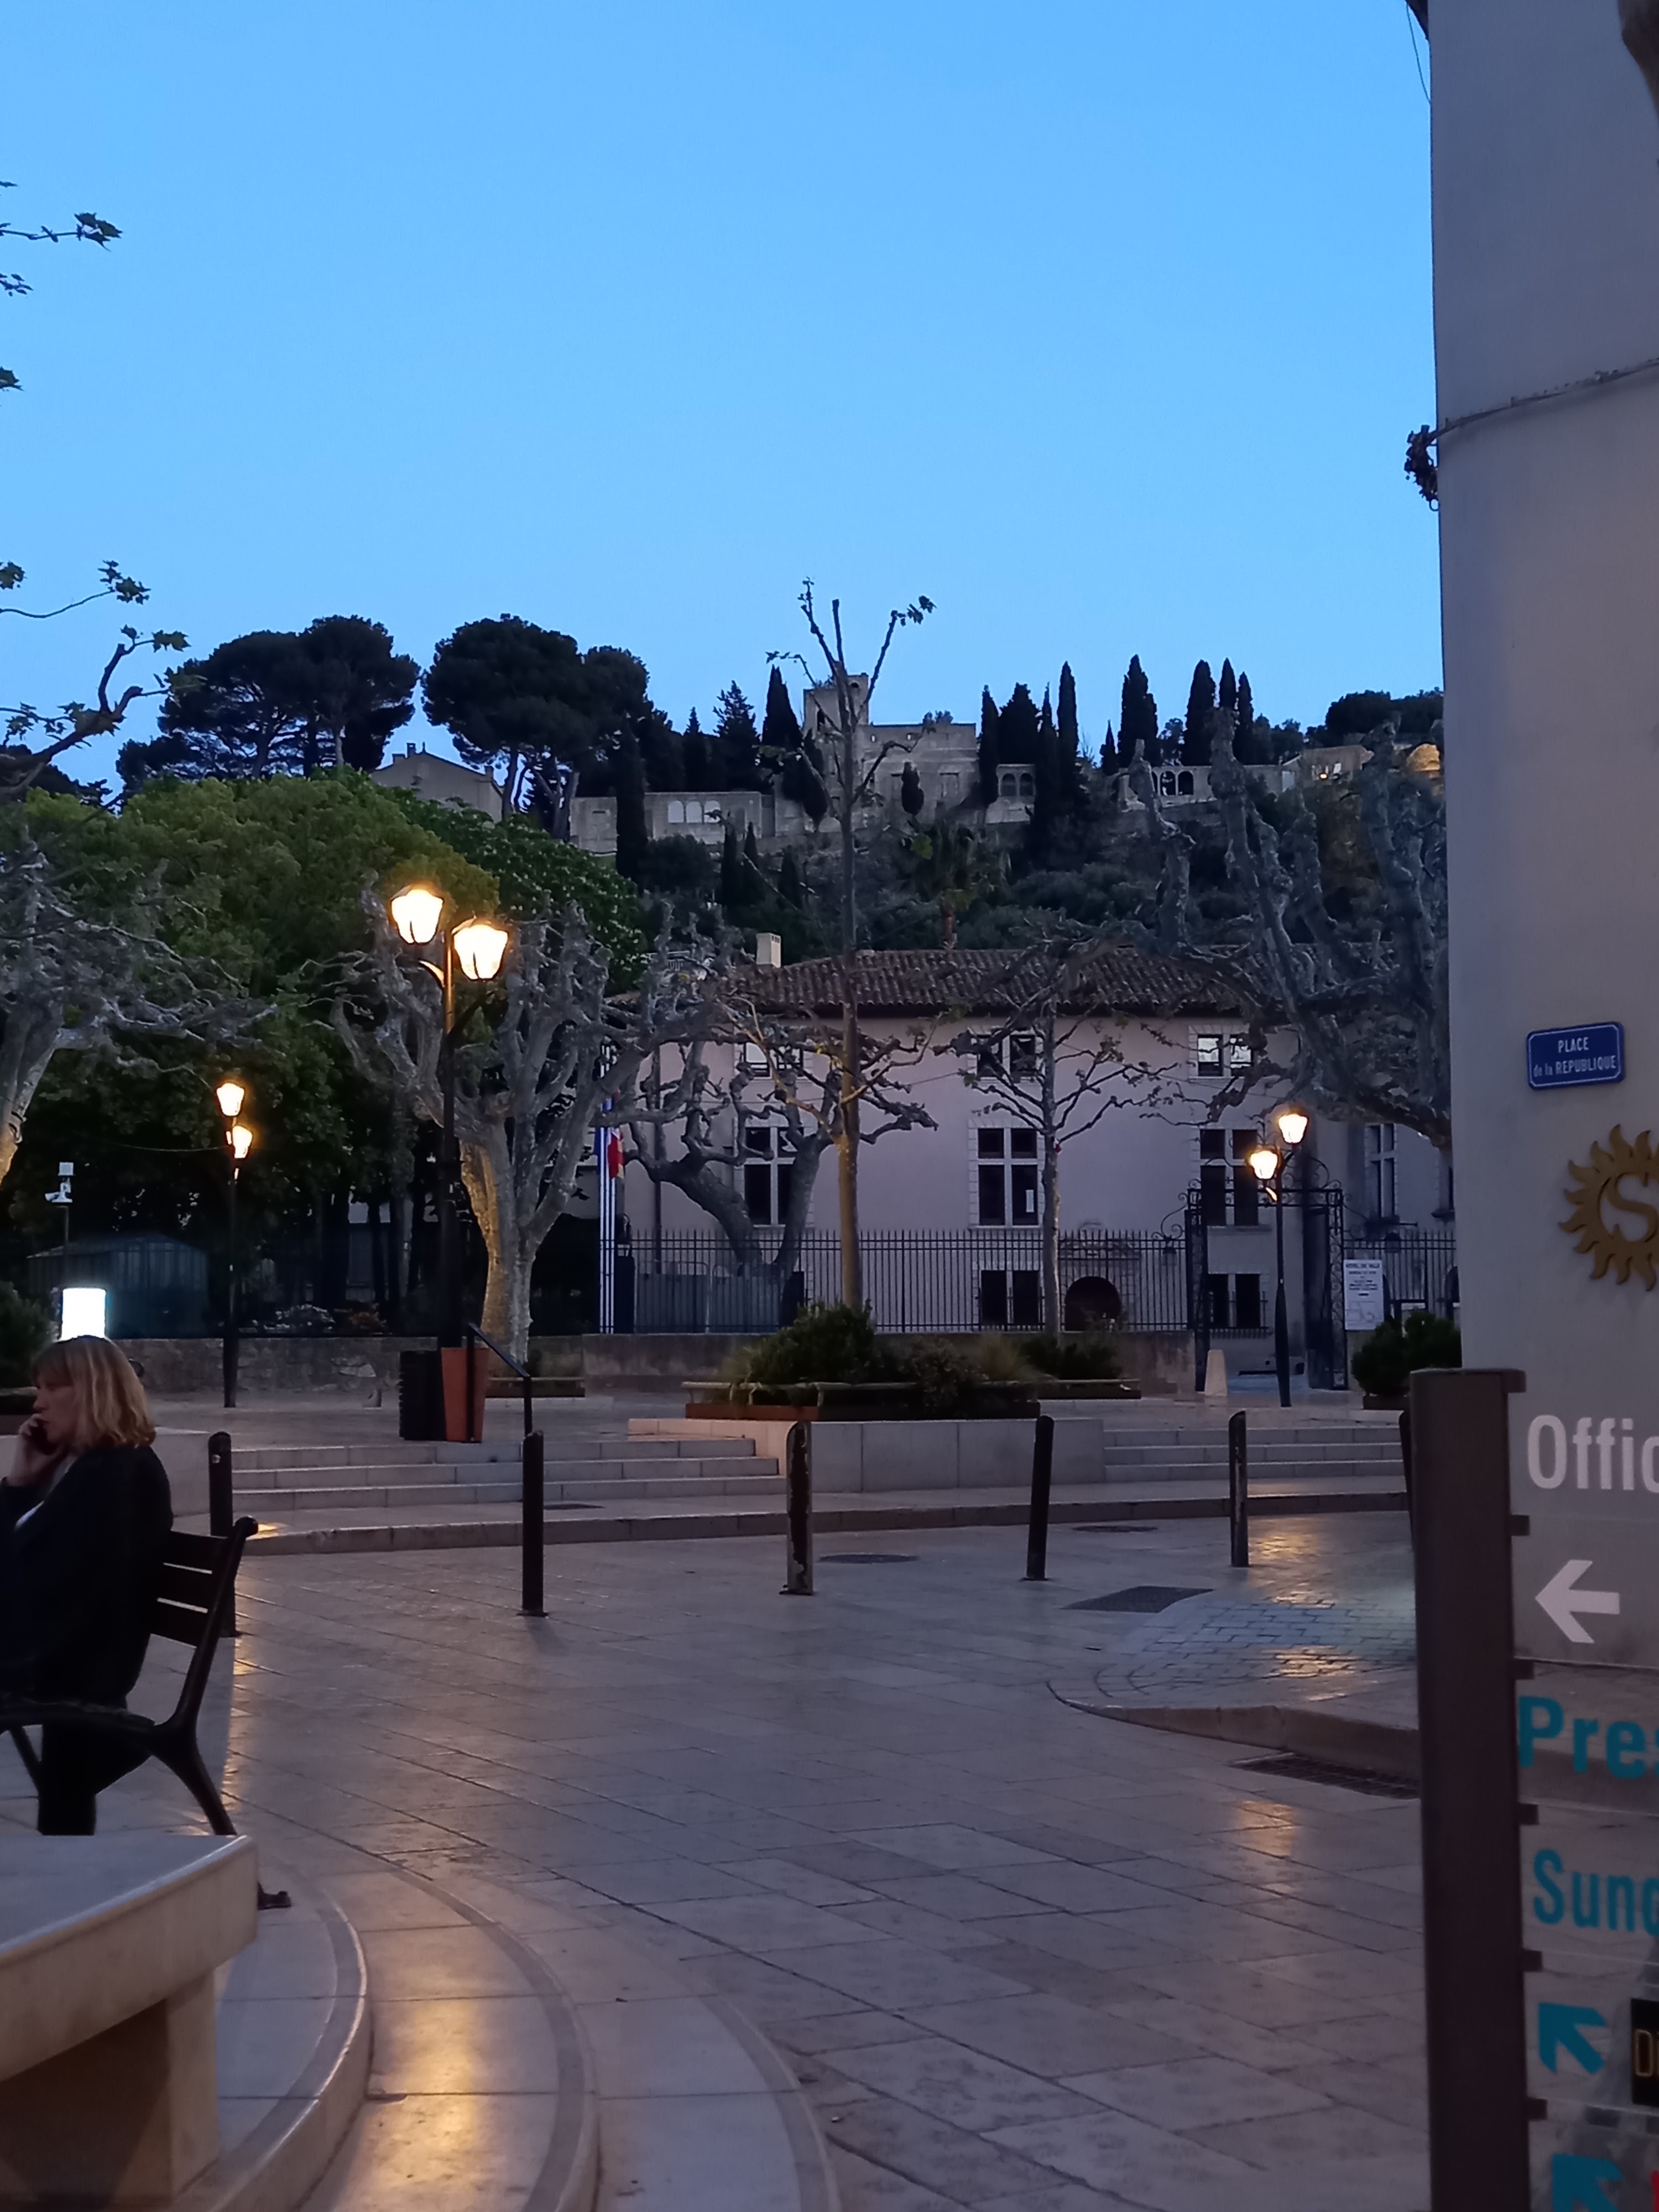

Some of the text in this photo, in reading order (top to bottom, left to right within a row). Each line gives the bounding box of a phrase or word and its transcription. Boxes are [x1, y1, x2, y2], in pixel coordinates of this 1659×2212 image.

[1558, 1037, 1590, 1053] PLACE
[1533, 1064, 1542, 1077] de
[1545, 1063, 1553, 1076] la
[1519, 1695, 1659, 1779] Pre
